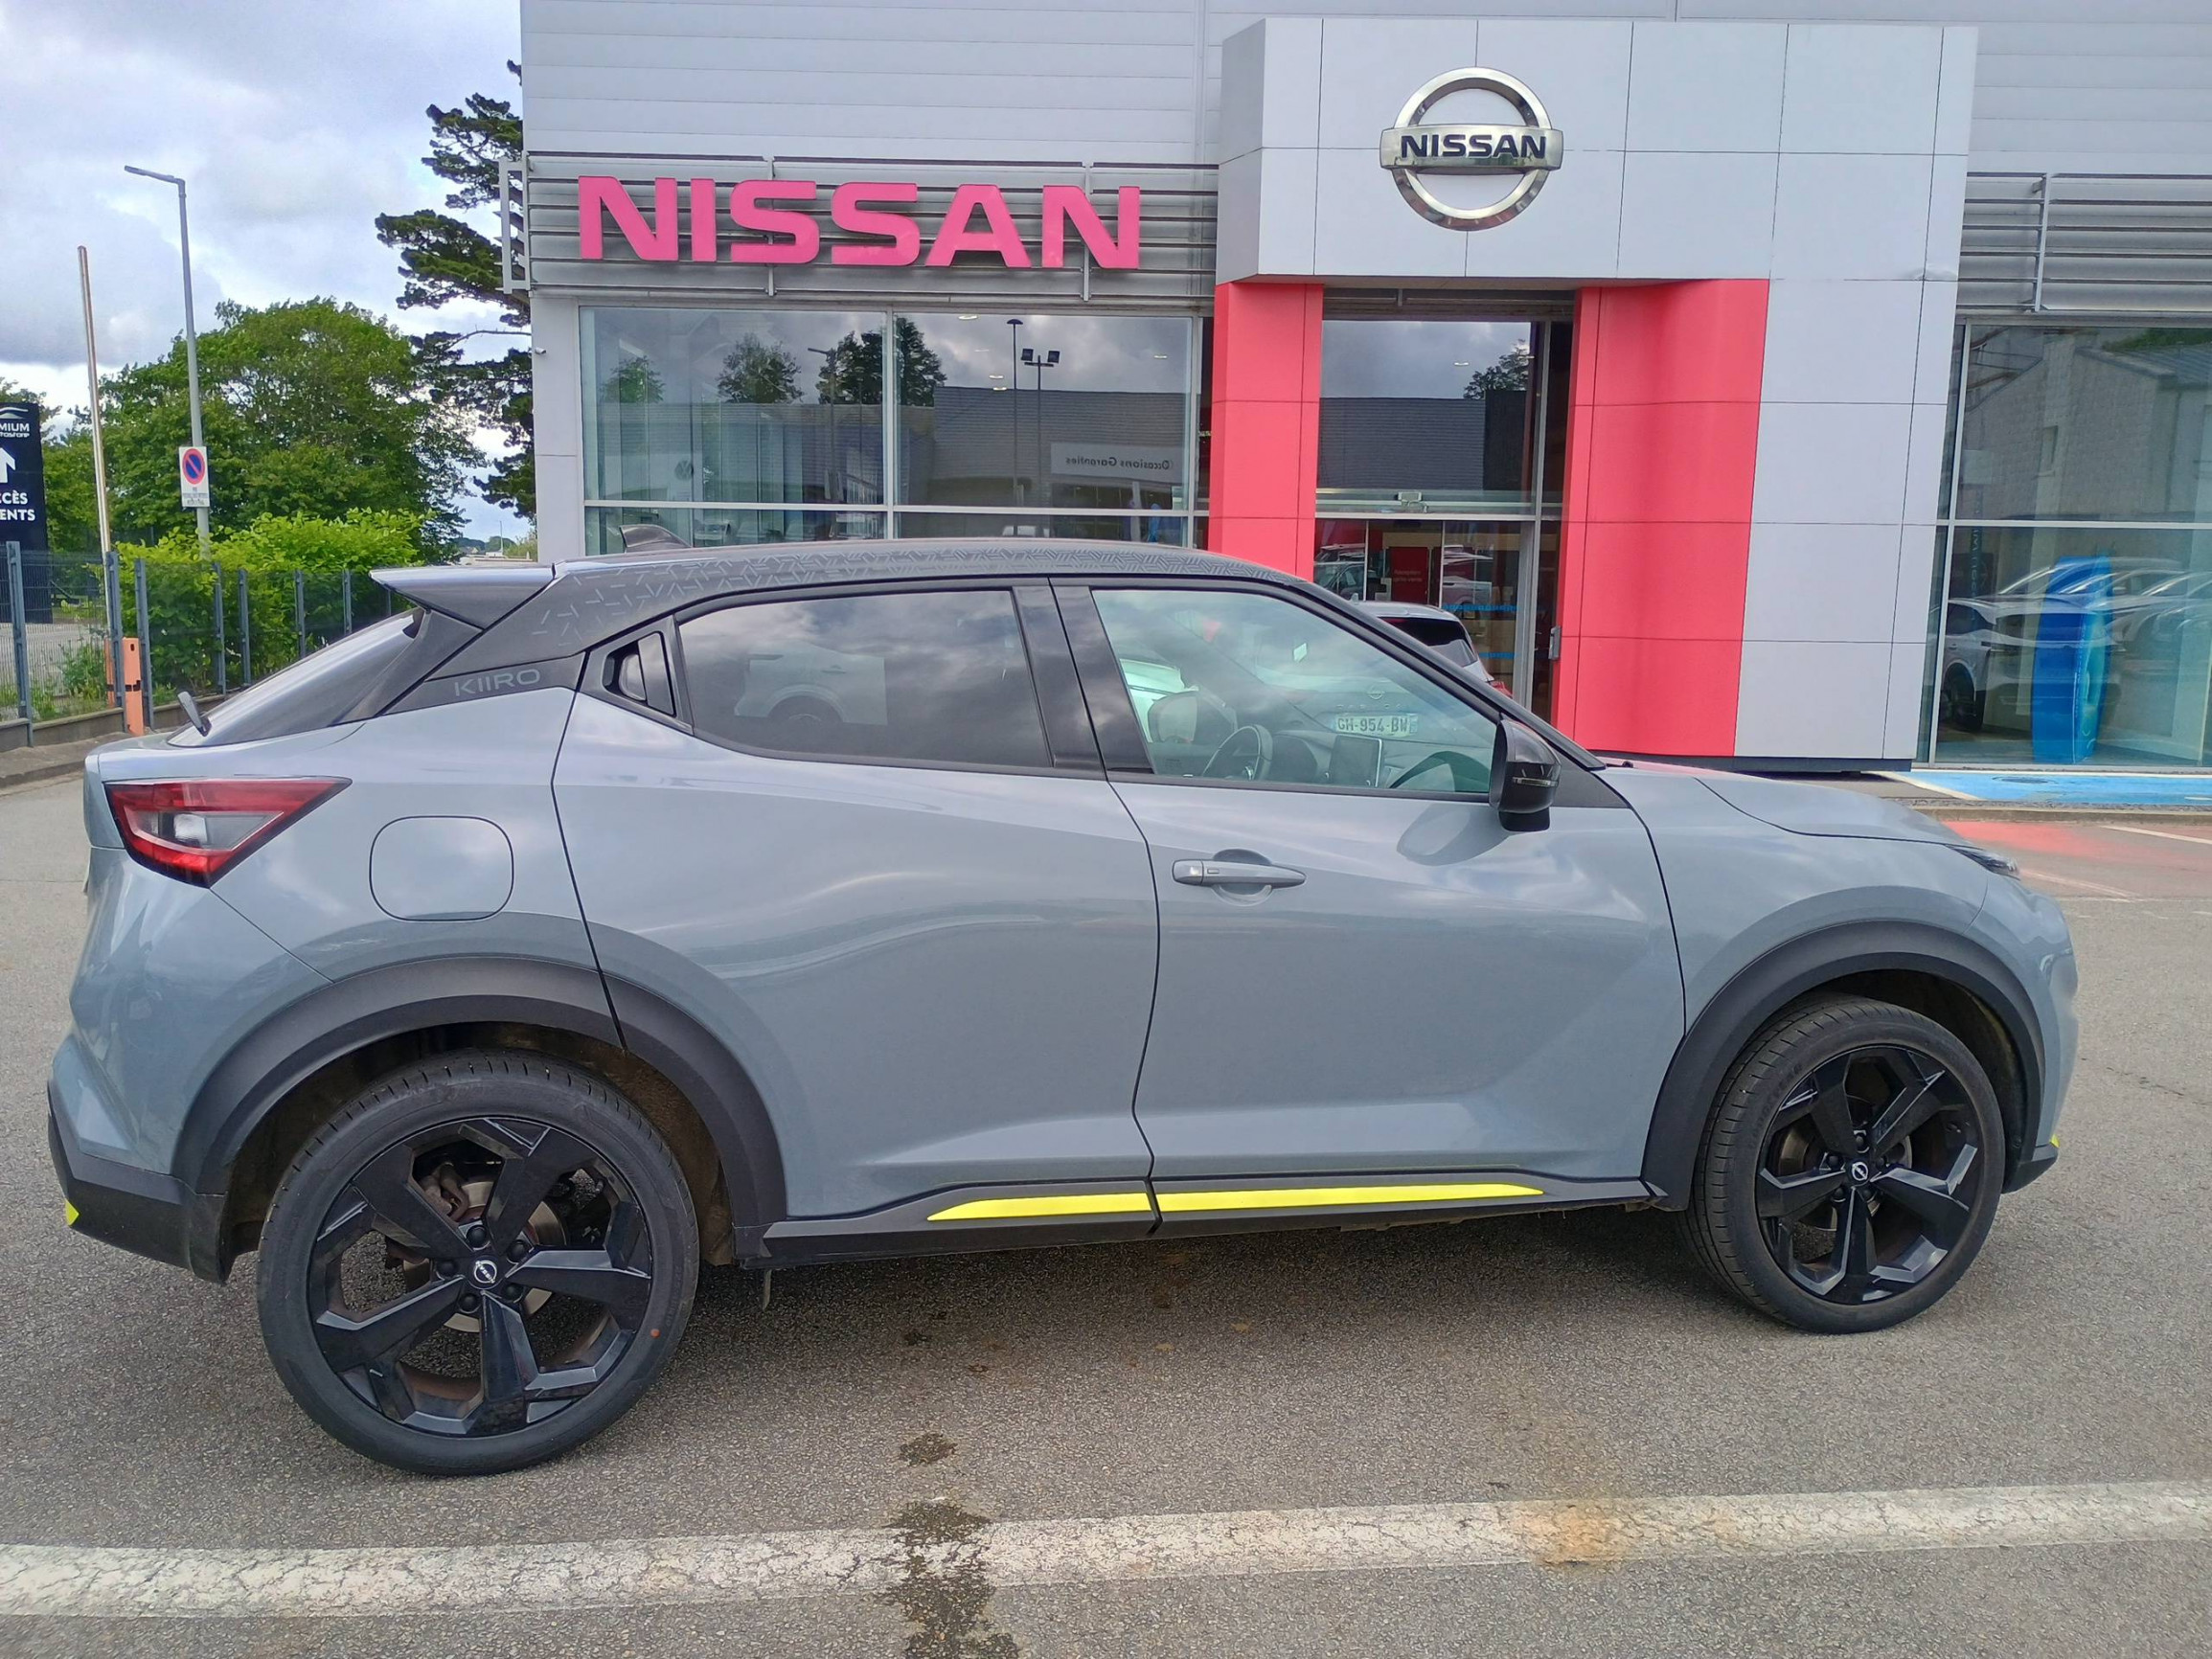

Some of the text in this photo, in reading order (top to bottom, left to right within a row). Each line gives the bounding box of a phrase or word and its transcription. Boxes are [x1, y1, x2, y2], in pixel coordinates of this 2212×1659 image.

[1401, 134, 1546, 160] NISSAN
[578, 175, 1140, 269] NISSAN
[0, 489, 28, 505] CÈS
[454, 669, 540, 696] KIIRO
